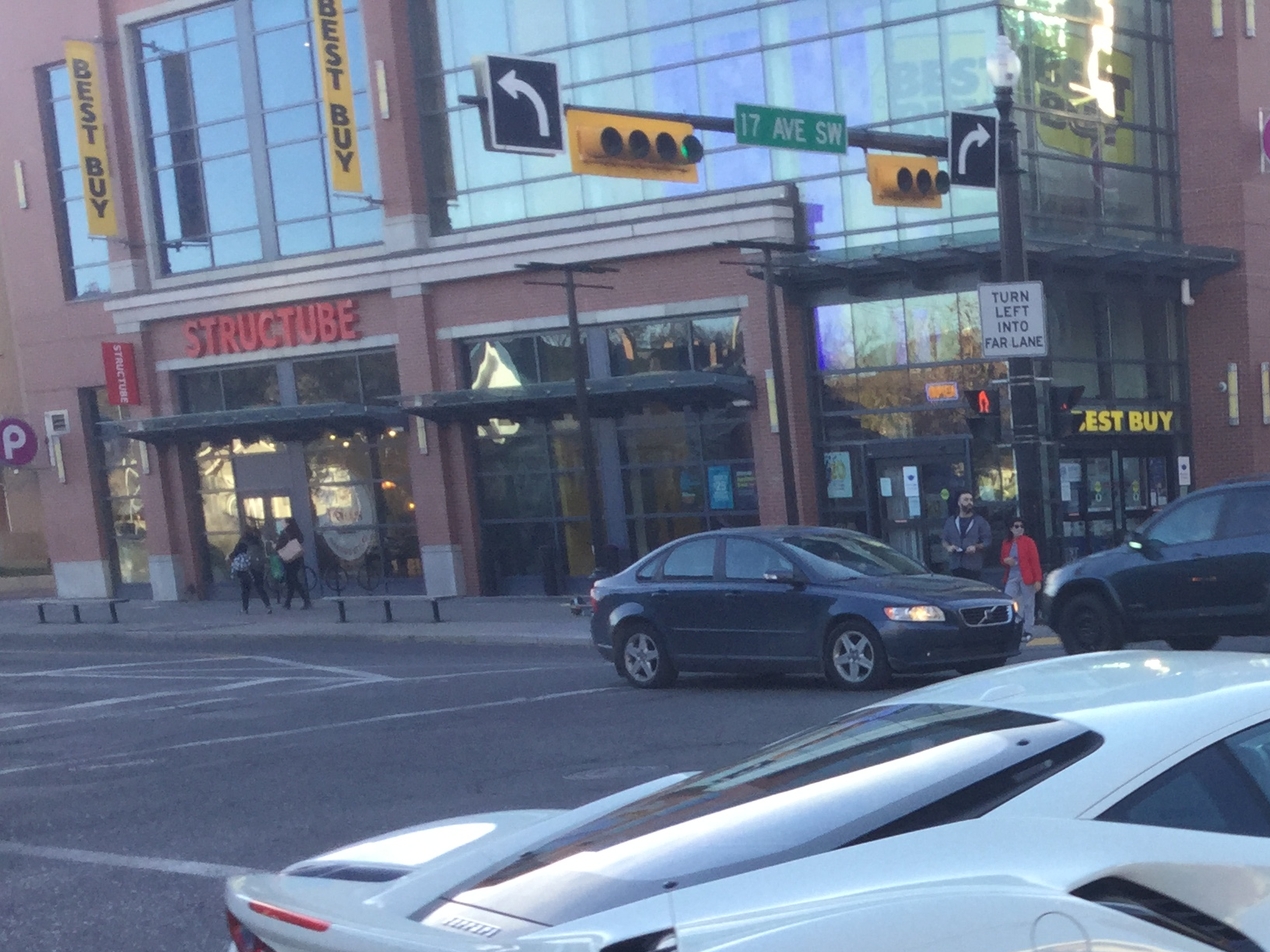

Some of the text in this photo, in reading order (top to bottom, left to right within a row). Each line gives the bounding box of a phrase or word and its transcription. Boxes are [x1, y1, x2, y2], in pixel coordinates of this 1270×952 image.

[317, 0, 354, 172] BEST BUY
[72, 58, 109, 218] BEST BUY
[741, 112, 843, 146] 17 AVE SW
[991, 290, 1029, 304] TURN
[995, 305, 1029, 318] LEFT
[182, 299, 360, 359] STRUCTUBE
[998, 320, 1029, 333] INTO
[985, 336, 1044, 349] FAR LANE
[113, 344, 129, 404] STRUCTUBE
[1128, 410, 1174, 432] BUY
